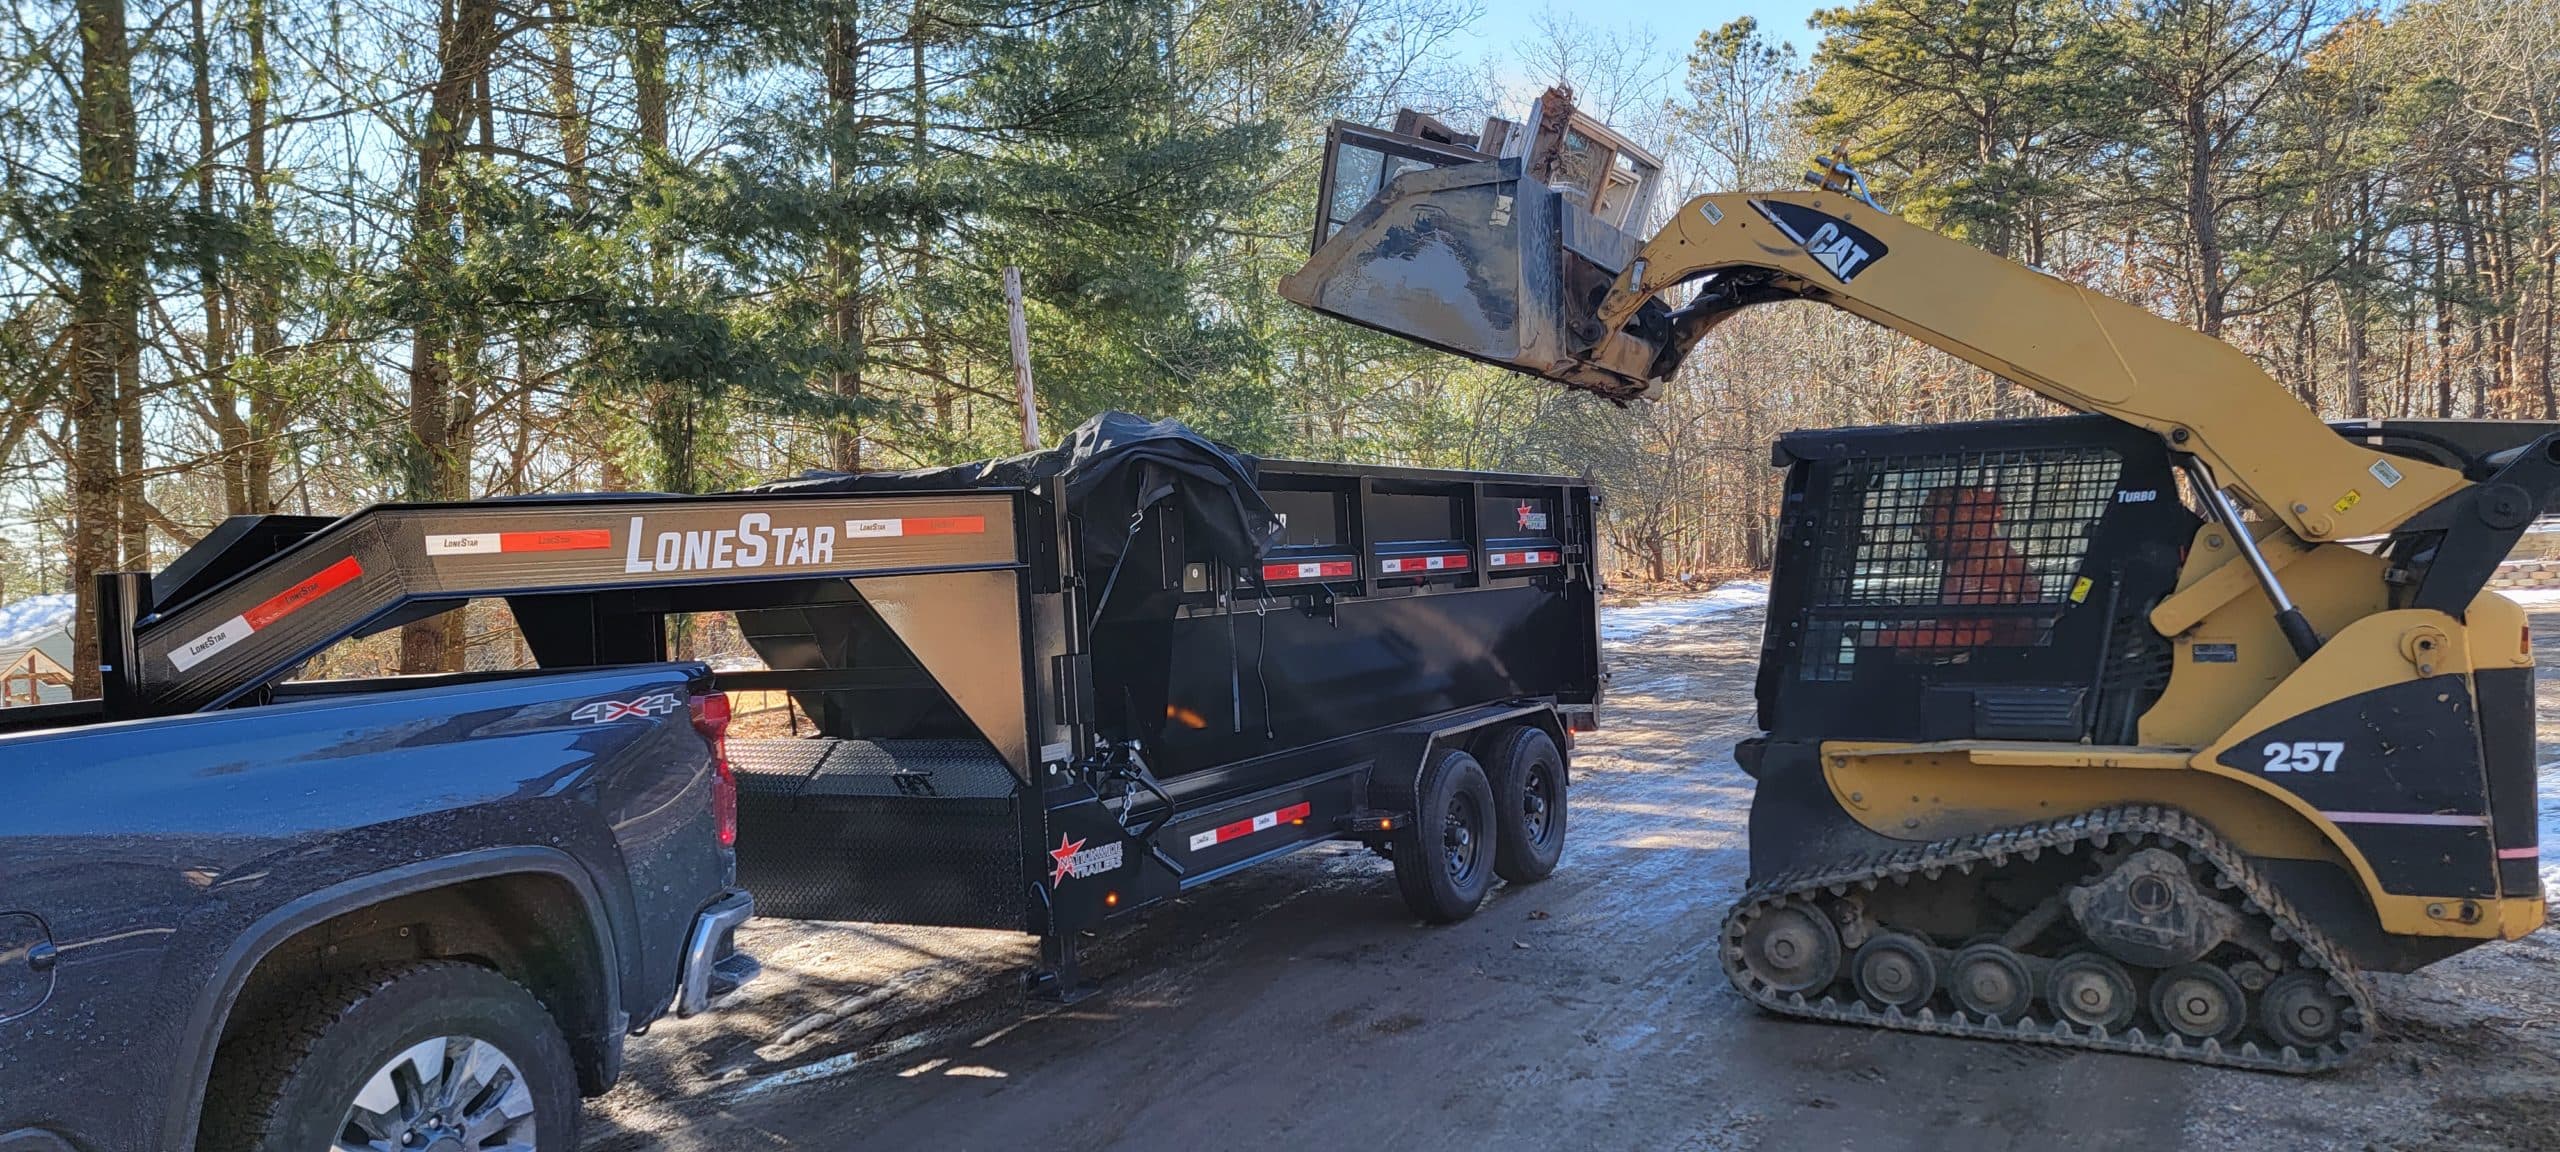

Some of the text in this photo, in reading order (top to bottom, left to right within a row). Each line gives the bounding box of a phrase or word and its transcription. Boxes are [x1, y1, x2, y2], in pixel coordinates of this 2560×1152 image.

[1807, 222, 1870, 280] CAT
[2117, 489, 2157, 503] TURBO
[571, 693, 682, 724] 4X4
[2263, 742, 2345, 772] 257
[1060, 841, 1122, 866] NATIONWIDE
[1075, 857, 1123, 879] TRAILERS
